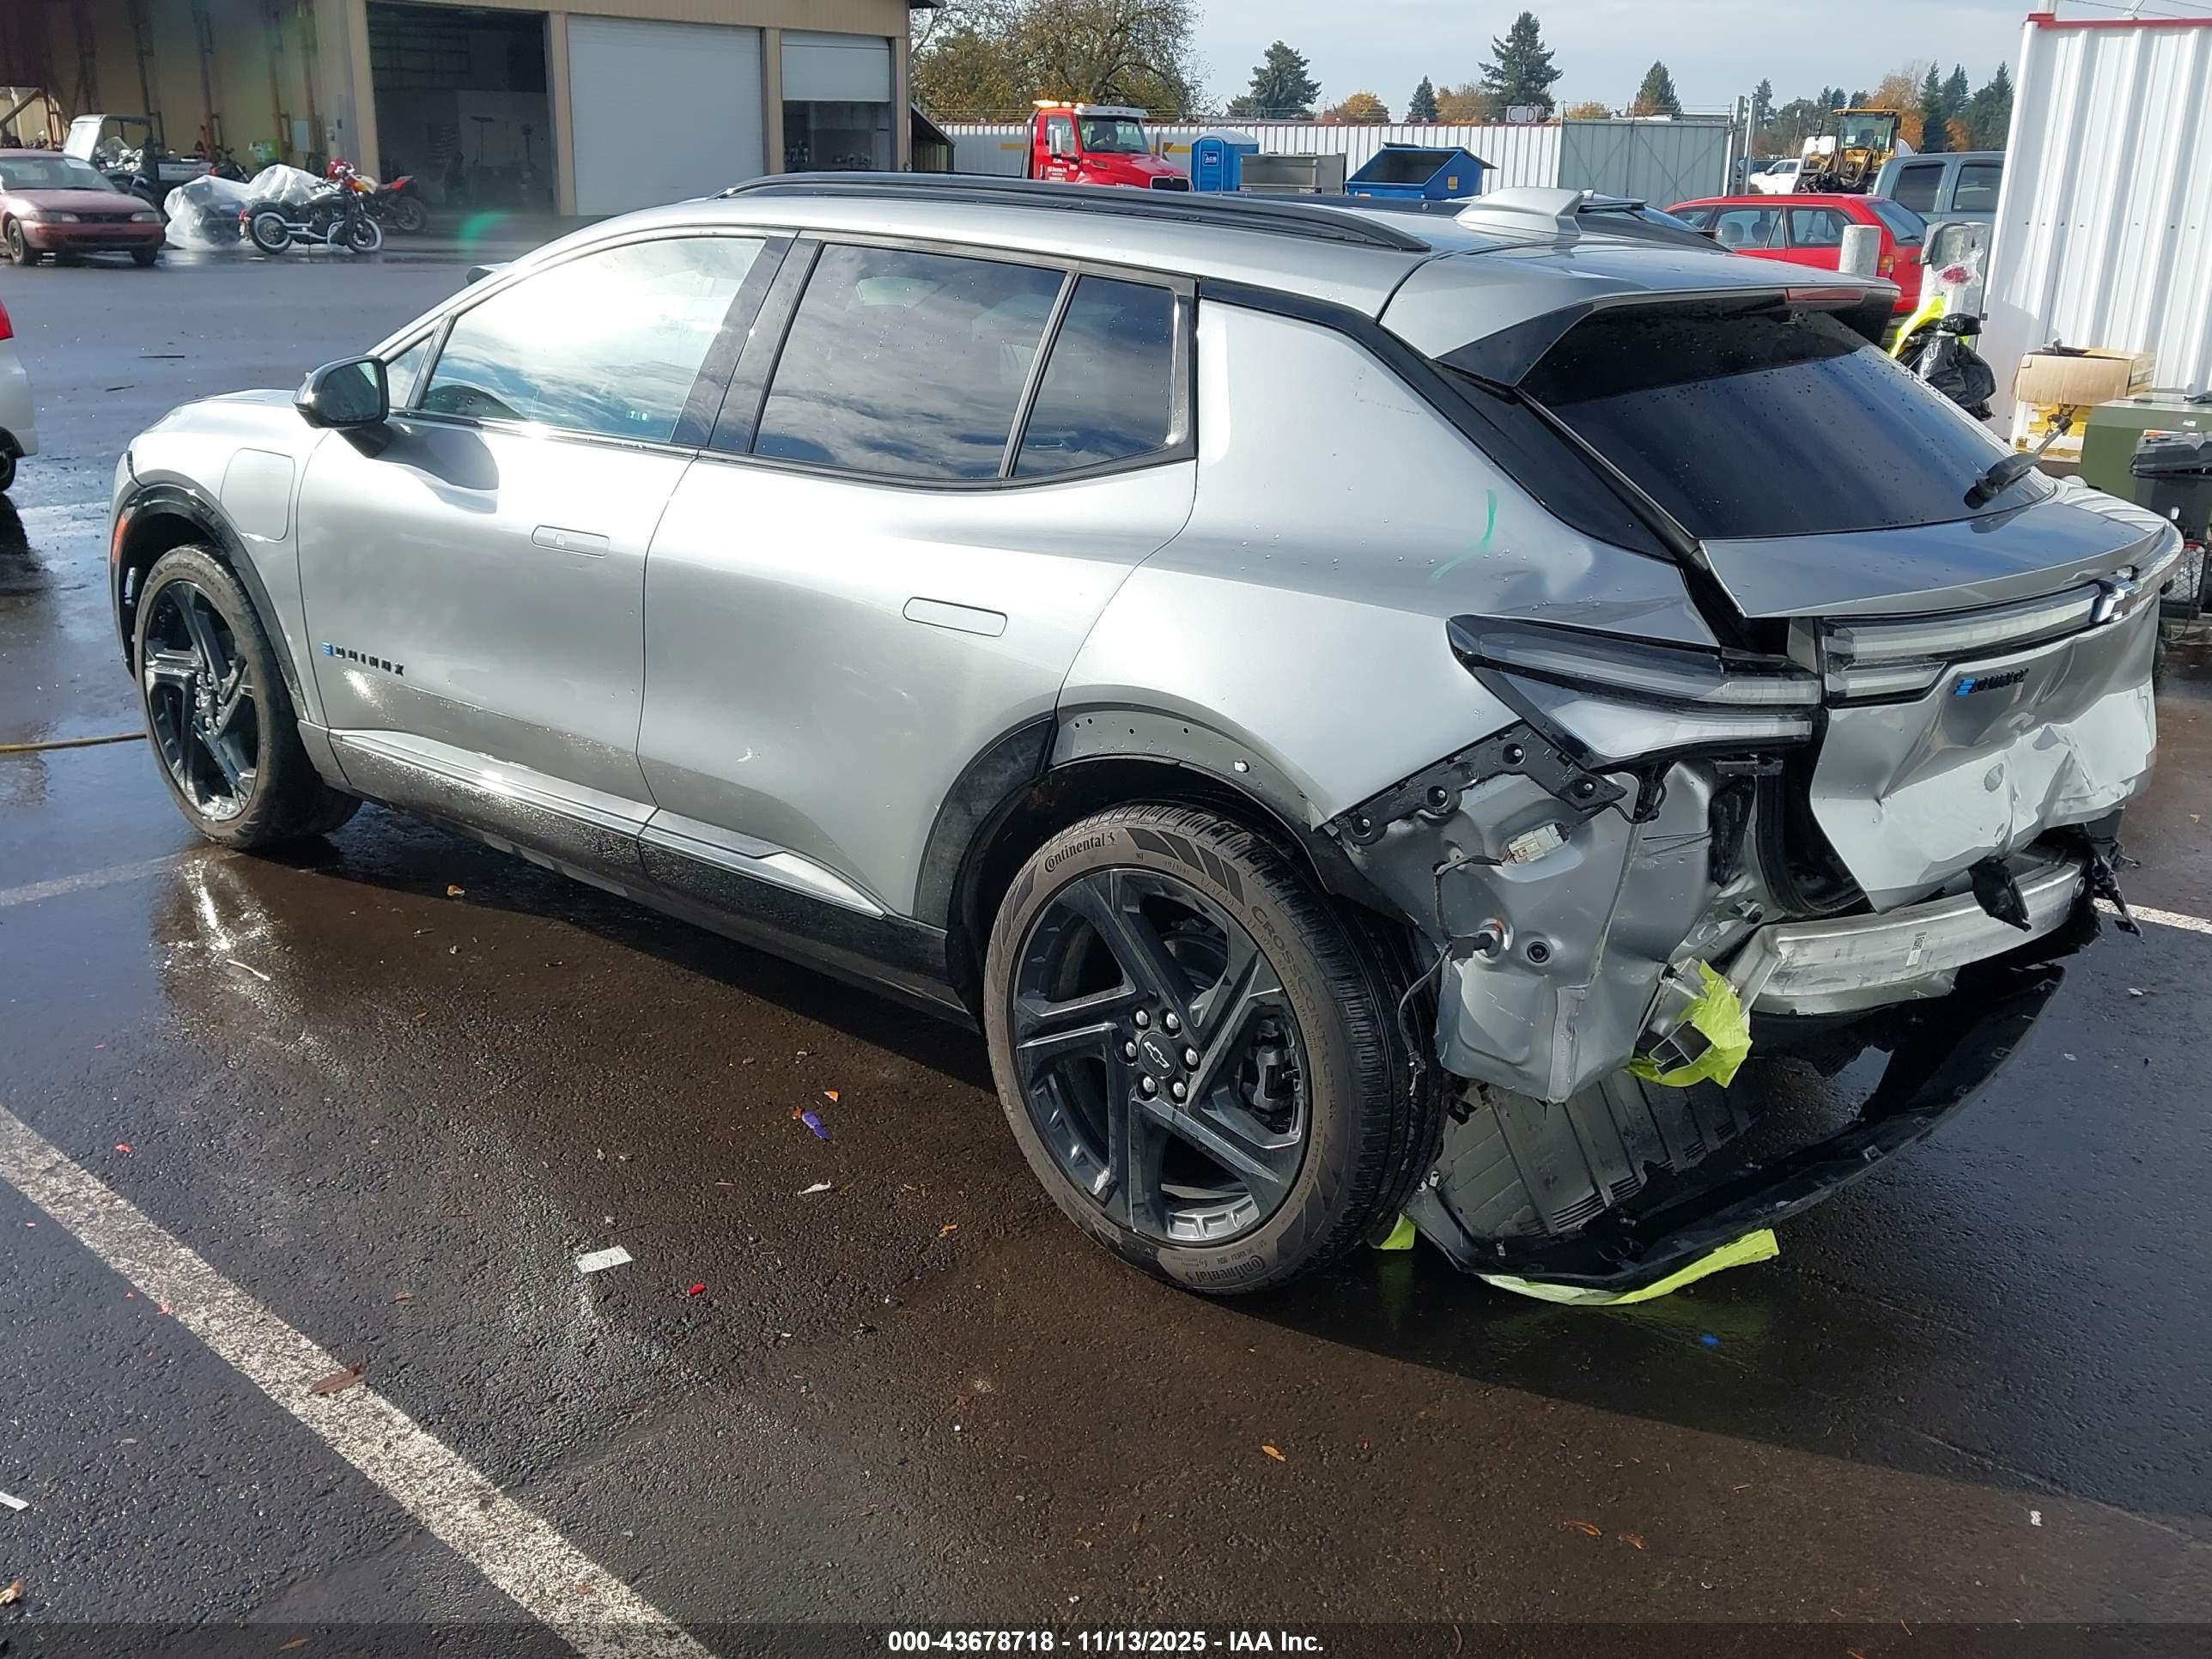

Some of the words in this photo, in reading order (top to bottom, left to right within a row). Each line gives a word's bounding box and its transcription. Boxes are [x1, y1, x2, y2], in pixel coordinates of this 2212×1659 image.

[1509, 106, 1517, 122] C
[1526, 106, 1536, 122] D
[1044, 833, 1106, 873] Continental
[1195, 1255, 1266, 1283] Continental
